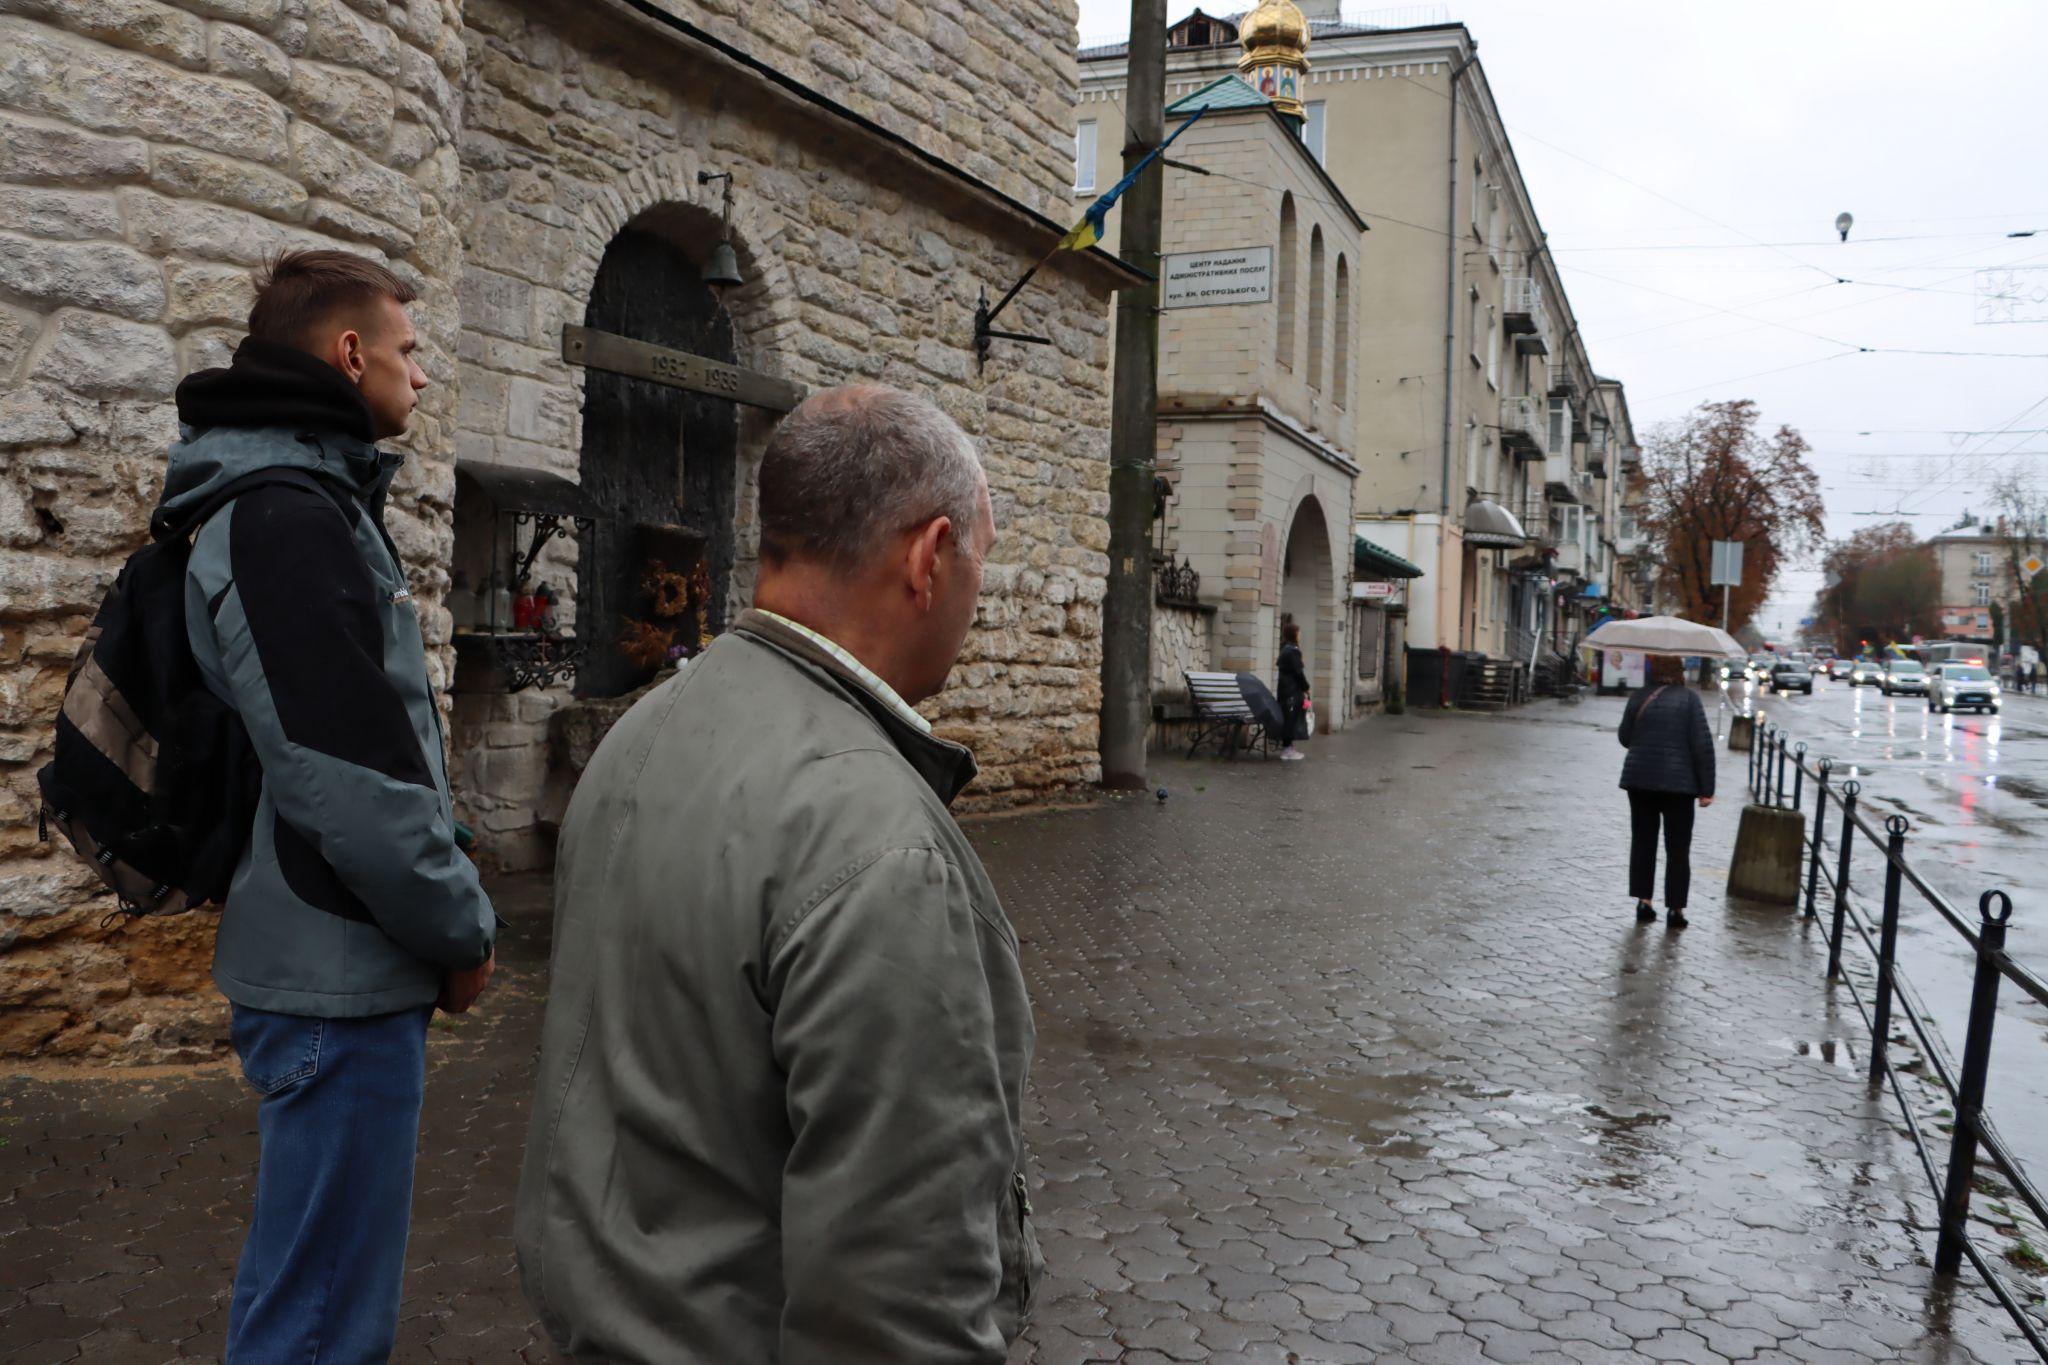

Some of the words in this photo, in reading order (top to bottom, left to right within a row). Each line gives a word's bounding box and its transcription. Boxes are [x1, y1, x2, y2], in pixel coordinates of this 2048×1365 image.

[1170, 269, 1238, 280] АДМІНІСТРАТИВНИХ
[1239, 265, 1266, 273] ПОСЛУГ
[652, 355, 688, 380] 1932
[704, 368, 738, 391] 1933
